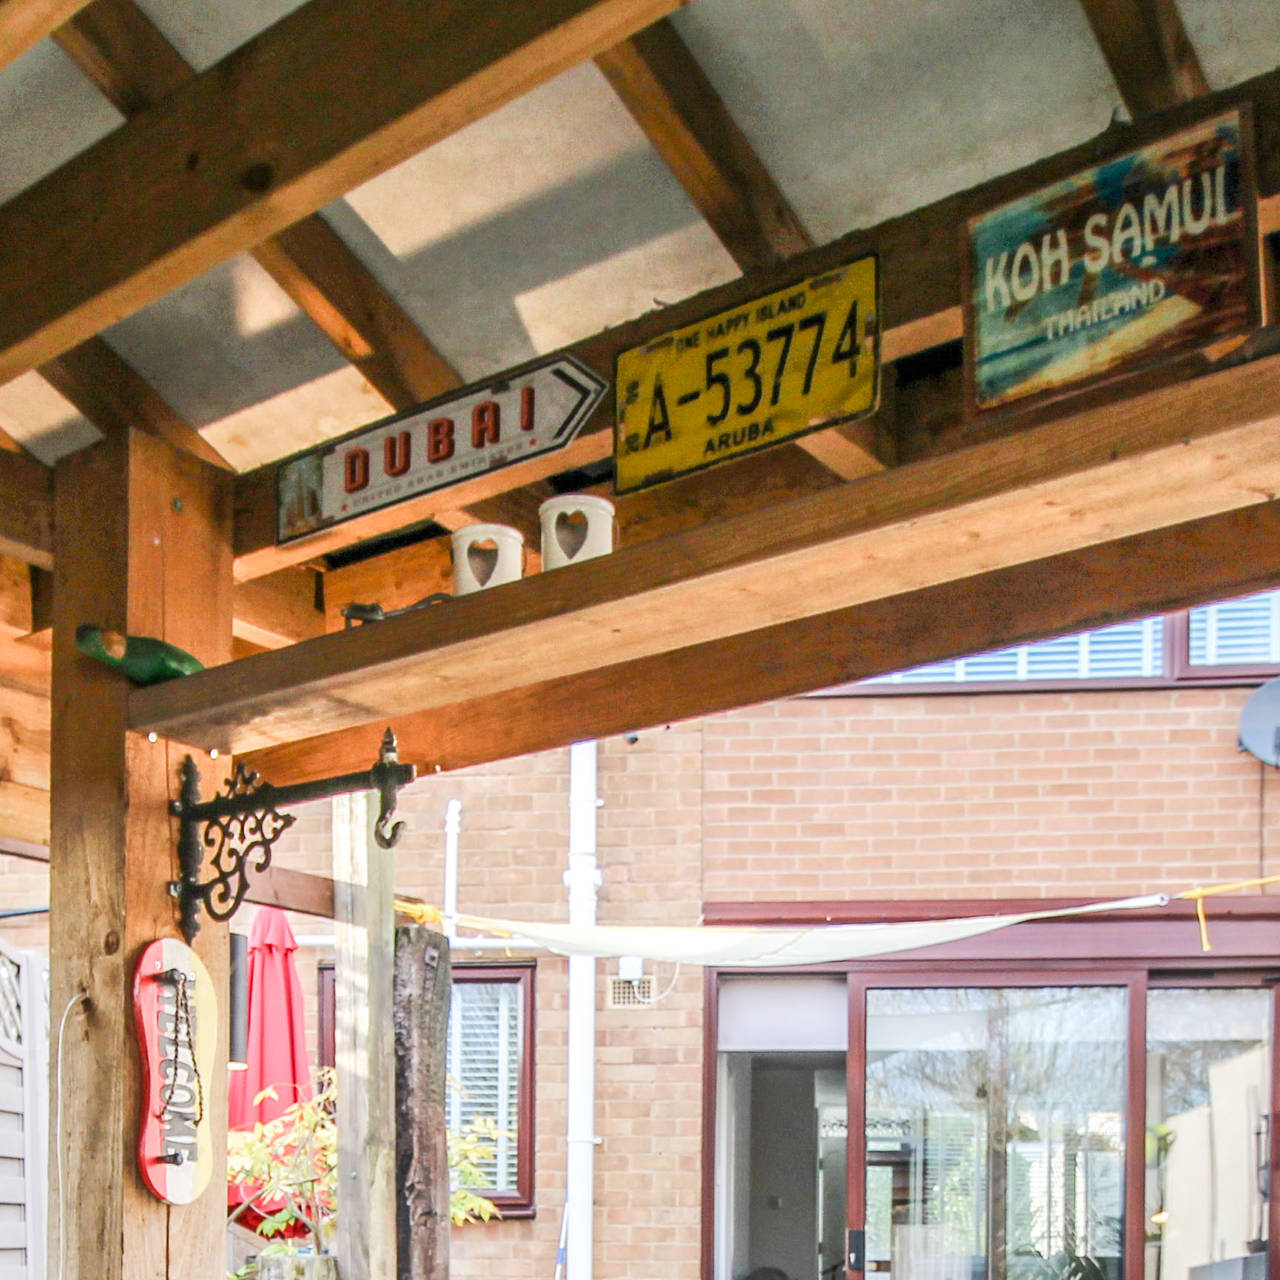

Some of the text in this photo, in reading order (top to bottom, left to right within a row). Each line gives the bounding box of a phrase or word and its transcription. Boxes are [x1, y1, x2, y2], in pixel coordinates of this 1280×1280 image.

[984, 165, 1234, 312] KOH SAMUI
[756, 292, 807, 323] ISLAND
[642, 298, 862, 450] A-53774
[343, 385, 537, 494] DUBAI
[703, 416, 775, 455] ARUBA
